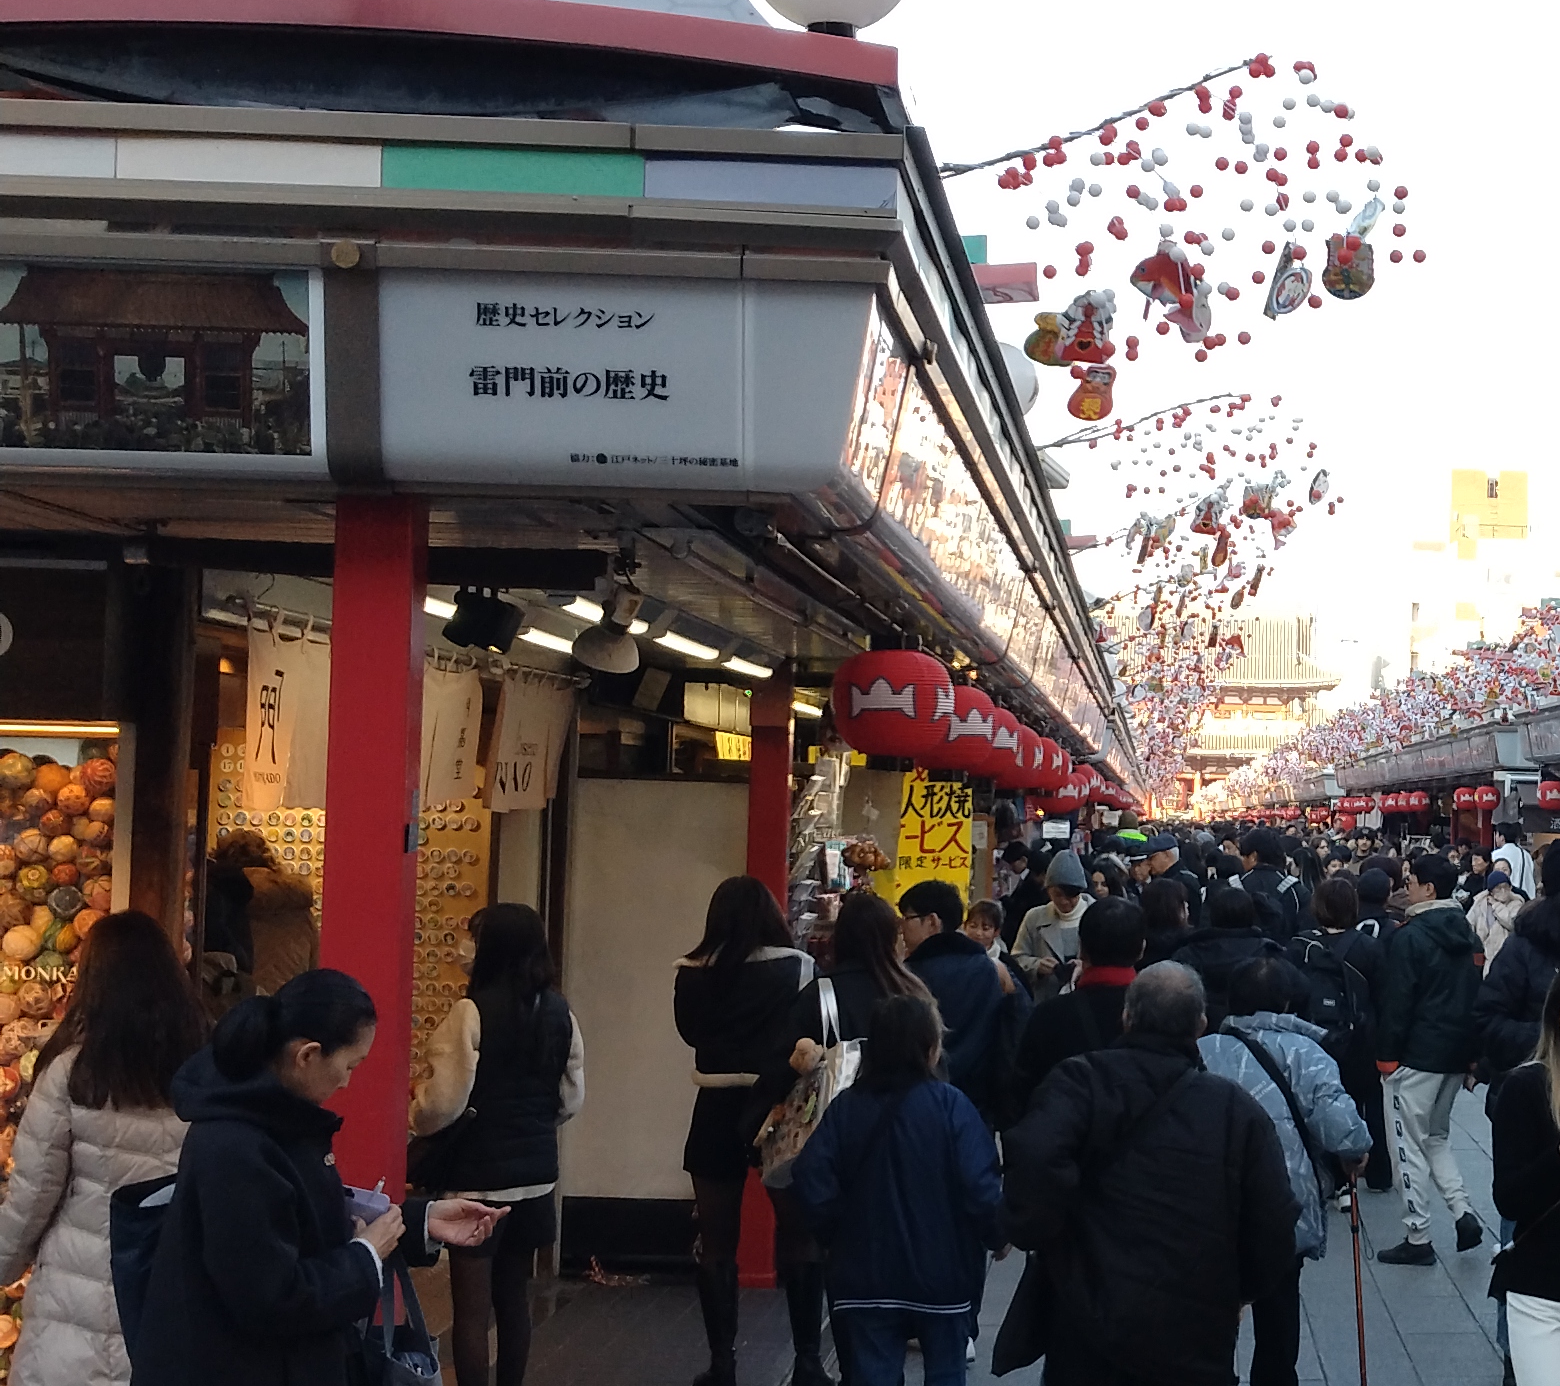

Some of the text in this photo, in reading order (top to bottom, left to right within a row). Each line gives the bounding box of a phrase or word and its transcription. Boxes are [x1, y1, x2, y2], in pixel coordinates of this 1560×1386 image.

[475, 301, 655, 329] 歴史セレクション
[468, 365, 670, 401] 雷門前の歴史
[900, 784, 972, 819] 人形焼
[900, 819, 970, 855] ービス
